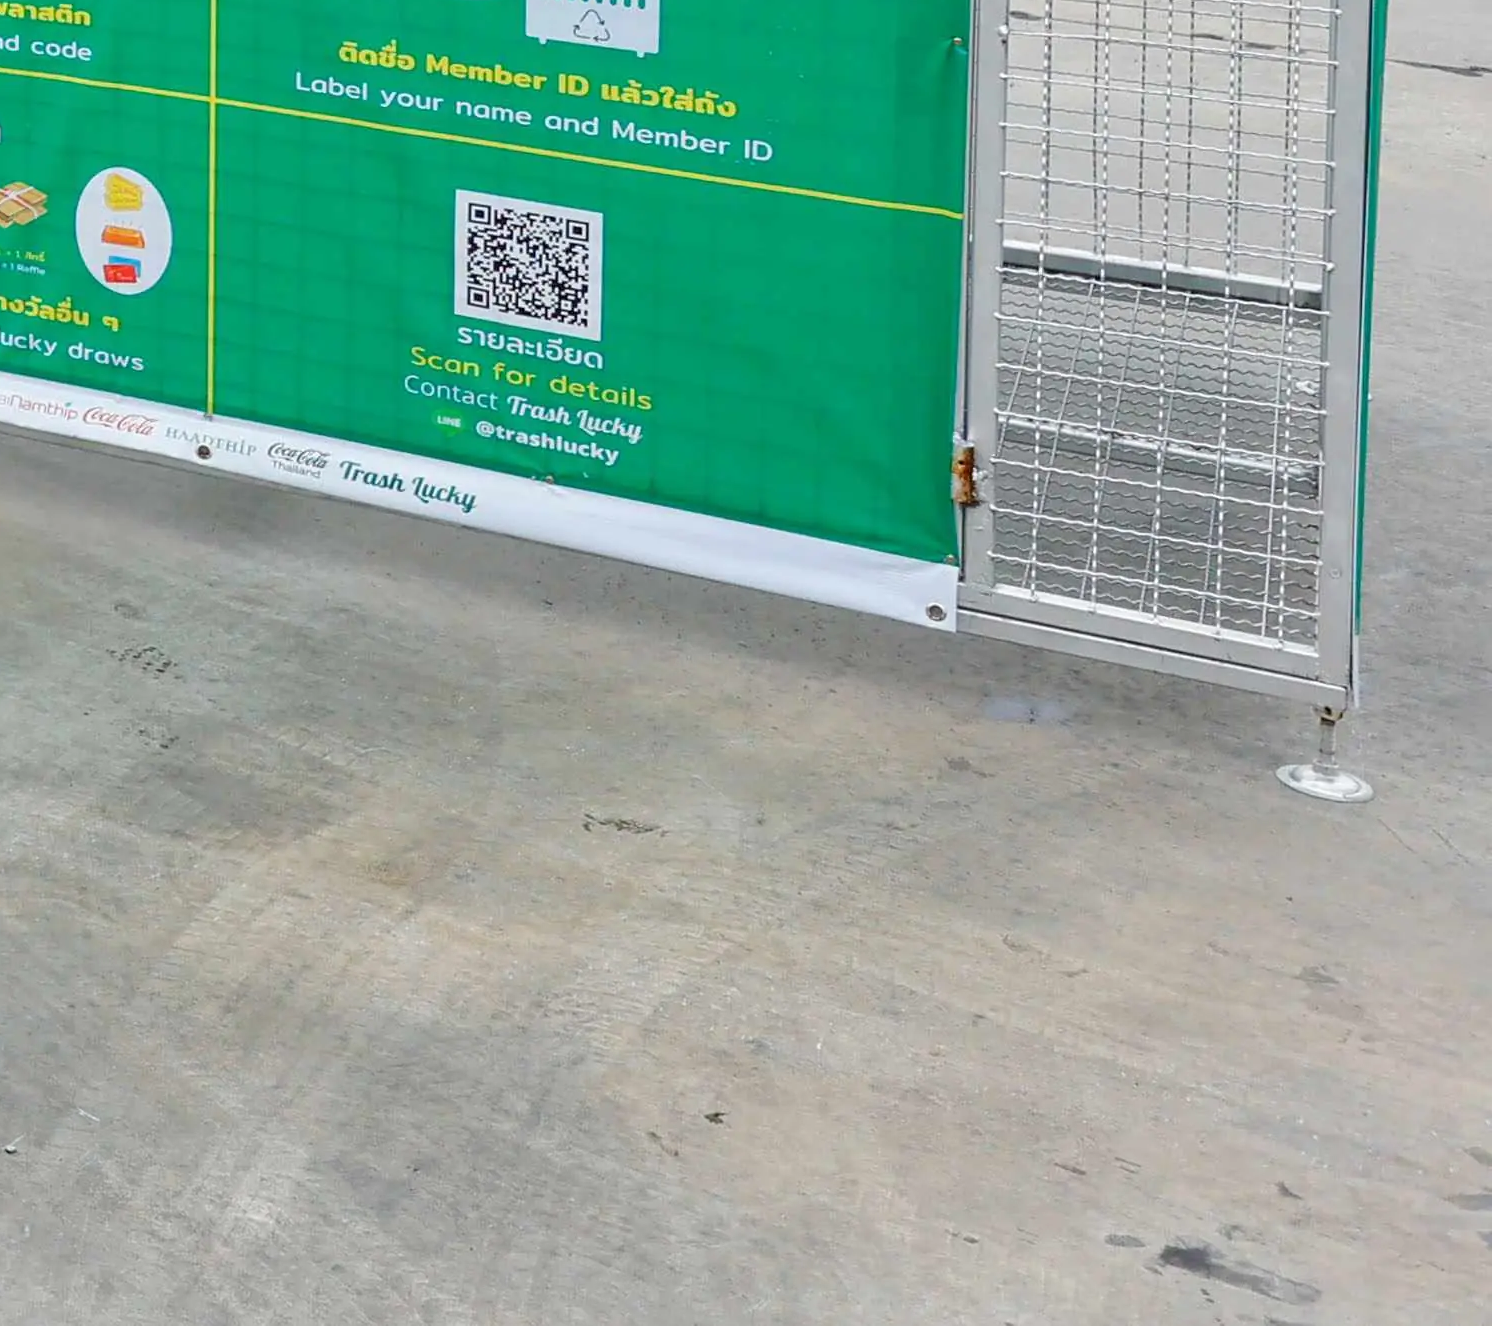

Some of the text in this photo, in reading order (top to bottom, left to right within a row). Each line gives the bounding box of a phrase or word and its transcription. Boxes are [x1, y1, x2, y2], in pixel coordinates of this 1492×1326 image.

[30, 38, 93, 62] code
[339, 39, 738, 118] ติดชื่อ Member ID แล้วใส่ถัง
[295, 72, 773, 161] Label your name and Member ID
[67, 341, 145, 373] draws
[458, 326, 604, 370] รายละเอียด
[411, 346, 653, 410] Scan for details
[82, 405, 157, 438] Coca-Cola
[404, 374, 643, 444] Contact Trash Lucky
[267, 441, 332, 471] Coca-Cola
[436, 414, 619, 466] LINE @trashlucky
[271, 460, 321, 480] Thailand
[339, 458, 476, 514] Trash Lucky
